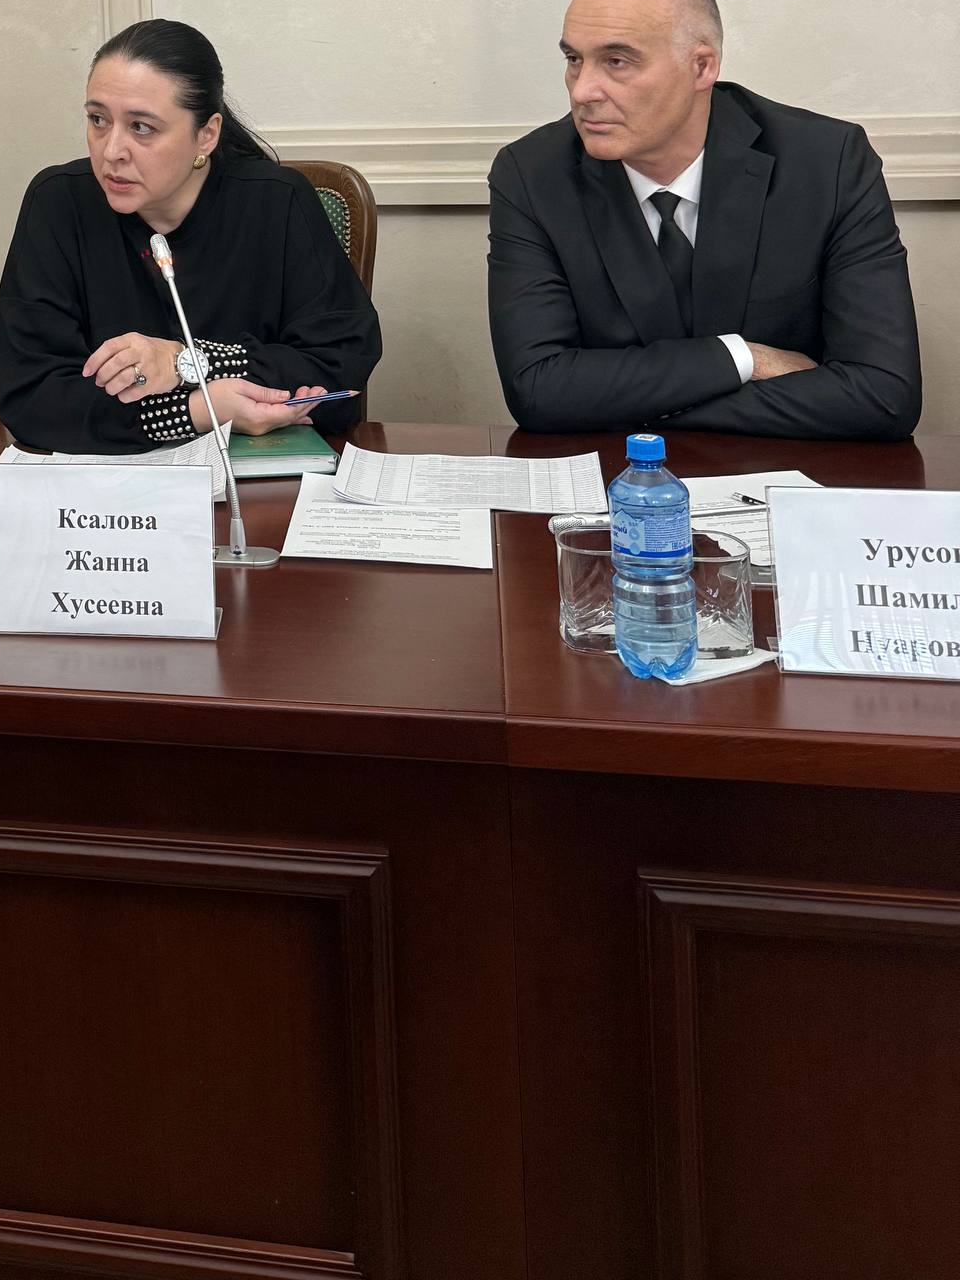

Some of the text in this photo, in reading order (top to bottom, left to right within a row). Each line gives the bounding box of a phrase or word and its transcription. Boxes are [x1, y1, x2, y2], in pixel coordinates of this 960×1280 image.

[58, 508, 158, 531] Ксалова
[66, 550, 149, 573] Жанна
[51, 592, 165, 619] Хусеевна
